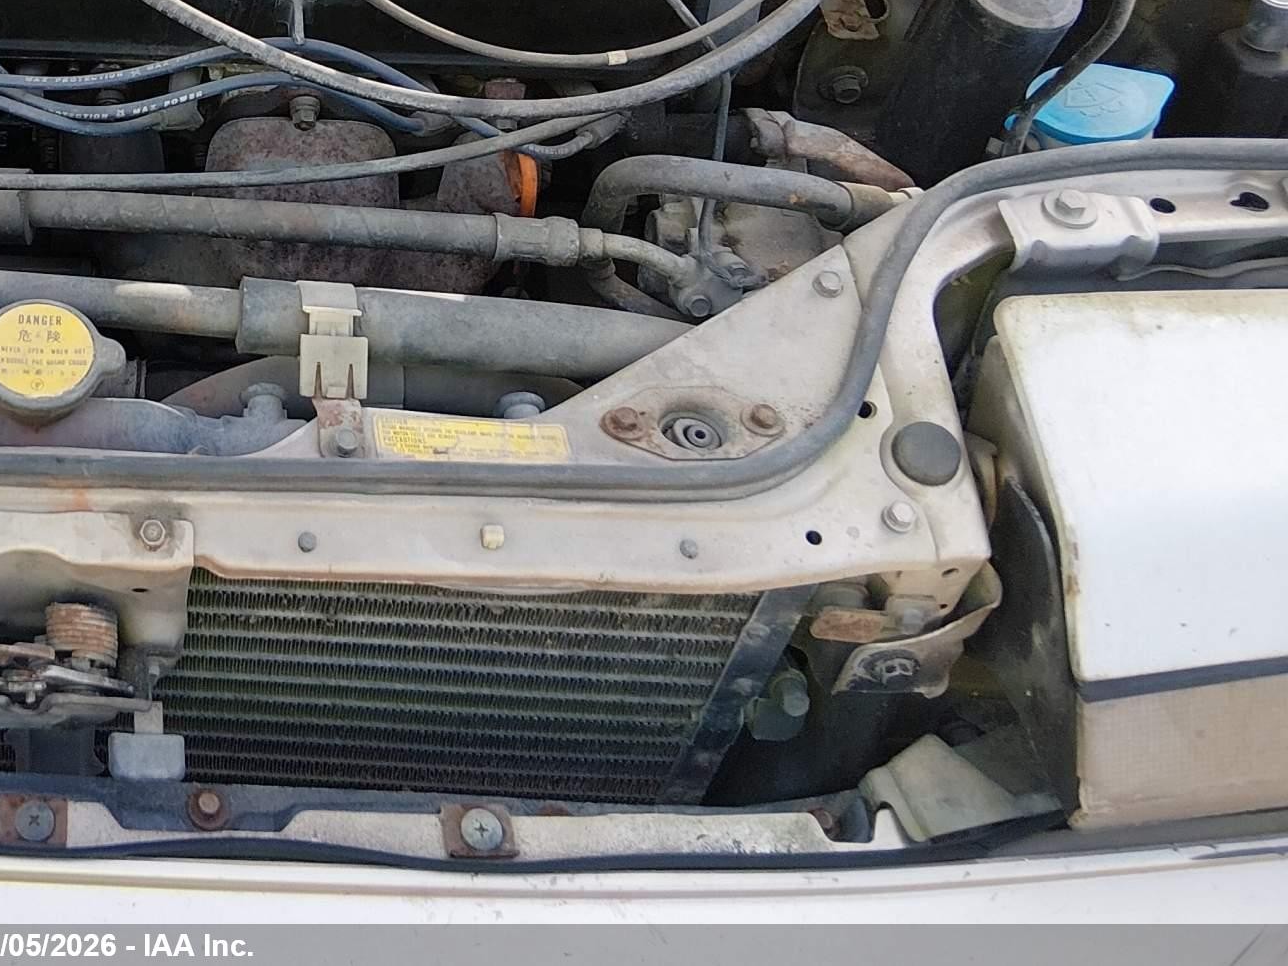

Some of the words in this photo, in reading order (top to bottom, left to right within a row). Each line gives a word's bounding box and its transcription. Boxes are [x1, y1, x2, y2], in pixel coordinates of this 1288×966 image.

[55, 73, 123, 83] PROTECTION
[133, 104, 157, 114] MAX
[164, 91, 203, 107] POWER
[18, 314, 62, 326] DANGER
[28, 346, 44, 354] OPEN
